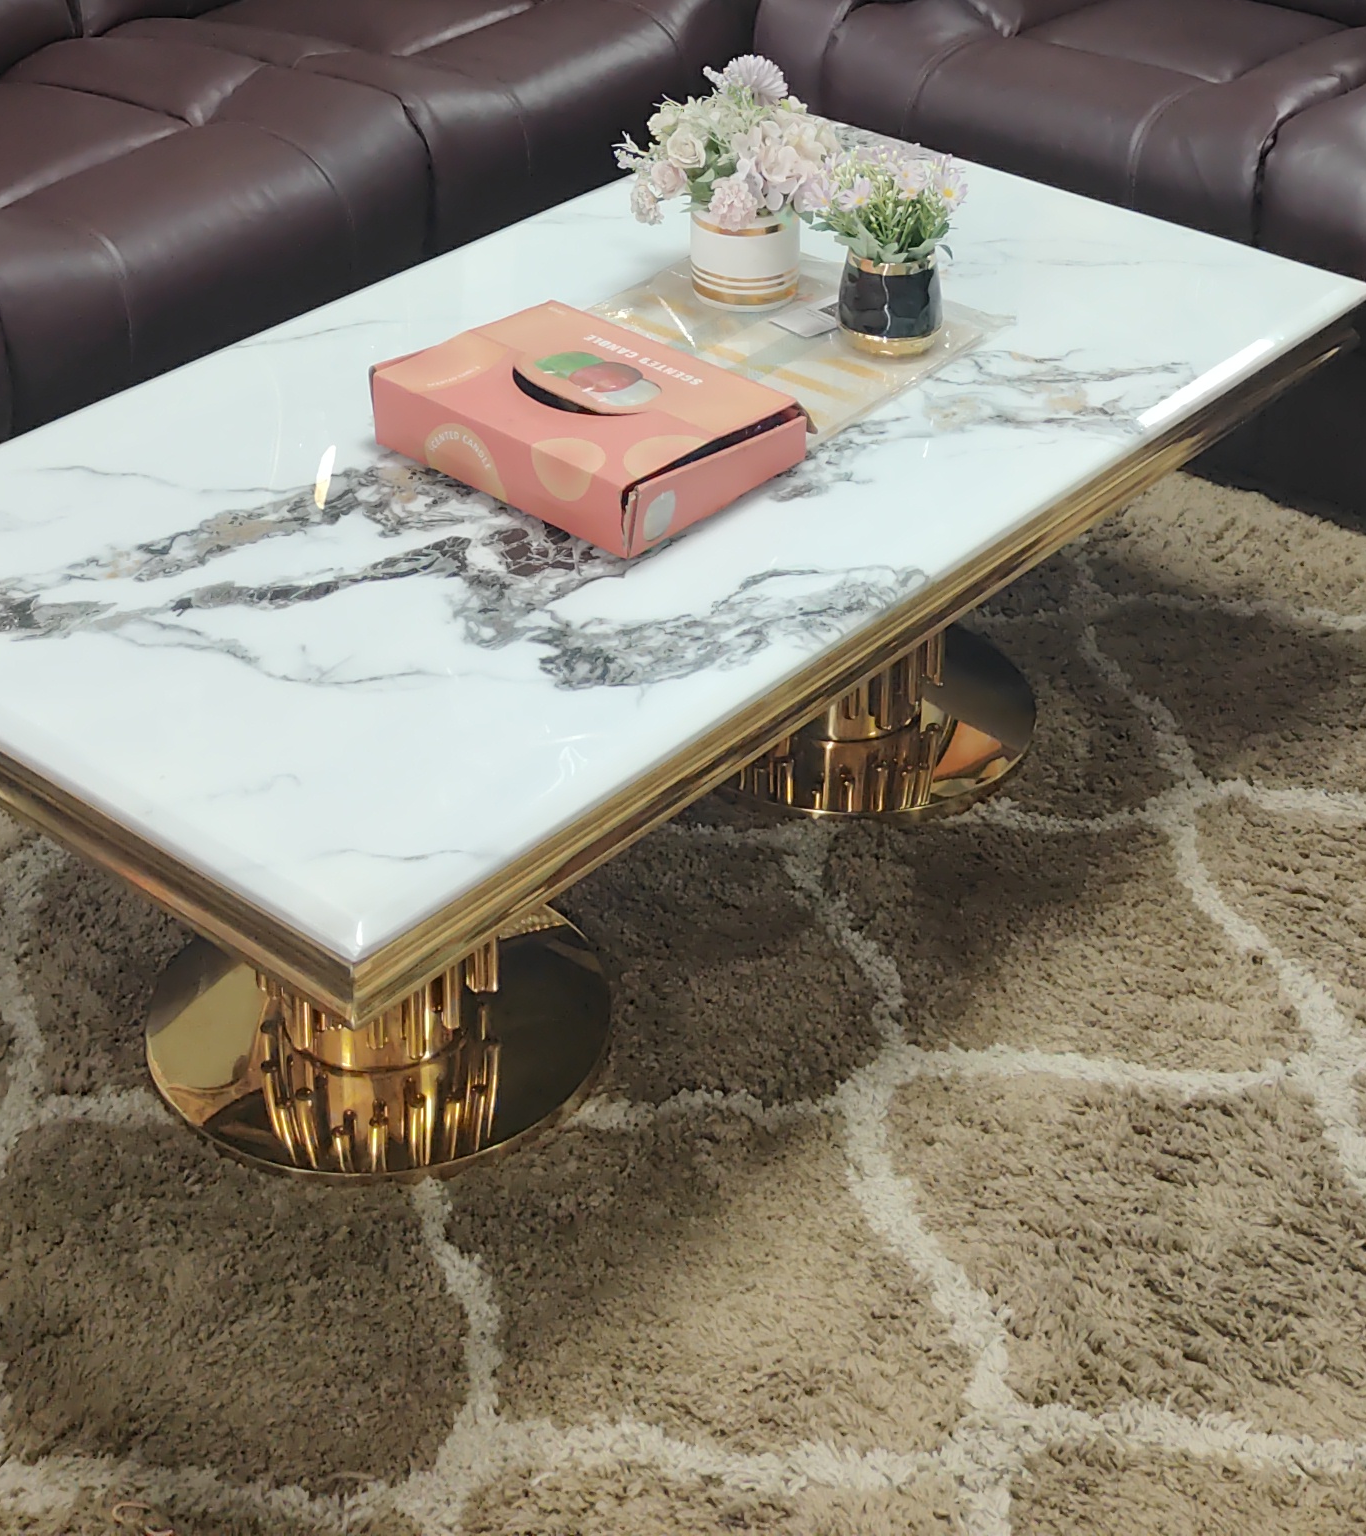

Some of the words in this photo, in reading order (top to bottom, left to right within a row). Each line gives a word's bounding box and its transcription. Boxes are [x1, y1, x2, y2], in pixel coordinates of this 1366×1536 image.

[583, 334, 639, 359] CANDLE
[638, 357, 704, 386] SCENTED
[429, 430, 460, 452] SCENTED
[462, 434, 492, 470] CANDLE
